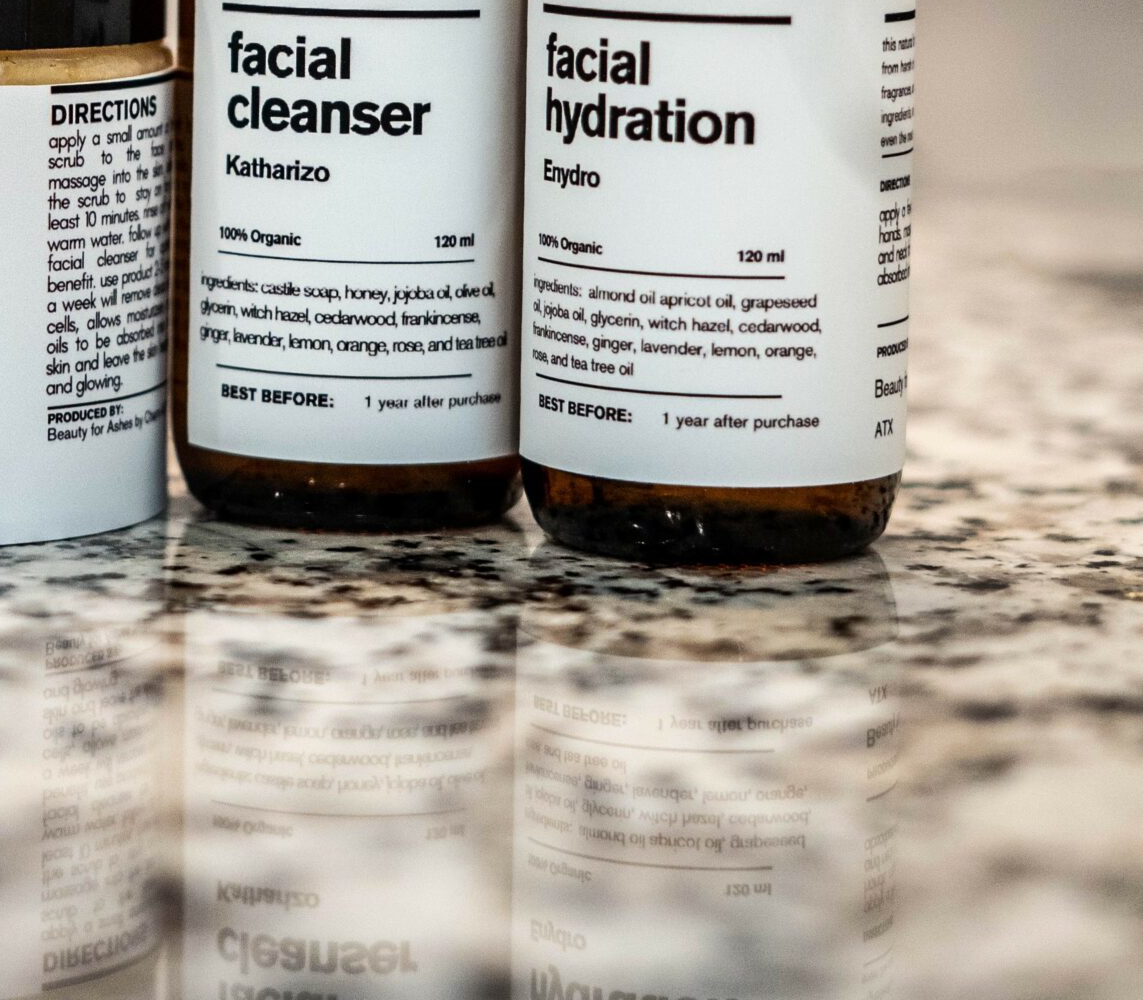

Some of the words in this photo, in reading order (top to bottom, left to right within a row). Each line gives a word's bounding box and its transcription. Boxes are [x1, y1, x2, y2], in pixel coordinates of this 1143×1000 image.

[228, 31, 351, 80] facial
[882, 37, 896, 52] this
[546, 32, 650, 86] facial
[52, 95, 156, 125] DIRECTIONS
[228, 86, 431, 136] cleanser
[546, 86, 755, 145] hydration
[49, 129, 86, 154] apply
[92, 134, 100, 146] a
[107, 125, 132, 144] small
[226, 154, 330, 182] Katharizo
[544, 158, 600, 189] Enydro
[48, 192, 70, 210] the
[78, 188, 109, 208] scrub
[116, 190, 126, 203] to
[219, 226, 248, 242] 100%
[251, 229, 301, 247] Organic
[435, 234, 457, 248] 120
[459, 233, 474, 247] ml
[538, 233, 559, 248] 100%
[561, 237, 603, 255] Organic
[738, 250, 763, 262] 120
[767, 250, 785, 263] ml
[589, 286, 635, 303] almond
[639, 290, 655, 304] oil
[660, 291, 711, 309] apricot
[715, 294, 735, 310] oil,
[741, 294, 817, 312] grapeseed
[573, 307, 587, 324] oil,
[591, 310, 643, 330] glycerin,
[648, 317, 687, 331] witch
[692, 318, 733, 334] hazel,
[738, 318, 821, 335] cedarwood,
[47, 336, 68, 354] oils
[75, 337, 88, 351] to
[96, 332, 110, 349] be
[592, 335, 636, 354] ginger,
[641, 339, 706, 358] lavender,
[711, 343, 760, 359] lemon,
[765, 344, 816, 361] orange,
[551, 352, 568, 367] and
[571, 356, 588, 371] tea
[591, 359, 615, 374] tree
[619, 362, 634, 376] oil
[46, 376, 72, 395] and
[76, 374, 123, 398] glowing.
[222, 384, 257, 401] BEST
[261, 389, 334, 408] BEFORE:
[365, 395, 371, 407] 1
[378, 396, 408, 412] year
[414, 395, 443, 409] after
[448, 393, 501, 409] purchase
[875, 376, 904, 398] Beauty
[48, 407, 107, 424] PRODUCED
[109, 404, 123, 417] BY:
[539, 394, 565, 412] BEST
[568, 401, 632, 423] BEFORE:
[663, 412, 668, 424] 1
[676, 415, 709, 430] year
[714, 414, 748, 429] after
[754, 414, 819, 431] purchase
[48, 425, 87, 441] Beauty
[91, 420, 104, 436] for
[107, 418, 133, 433] Ashes
[875, 419, 893, 439] ATX
